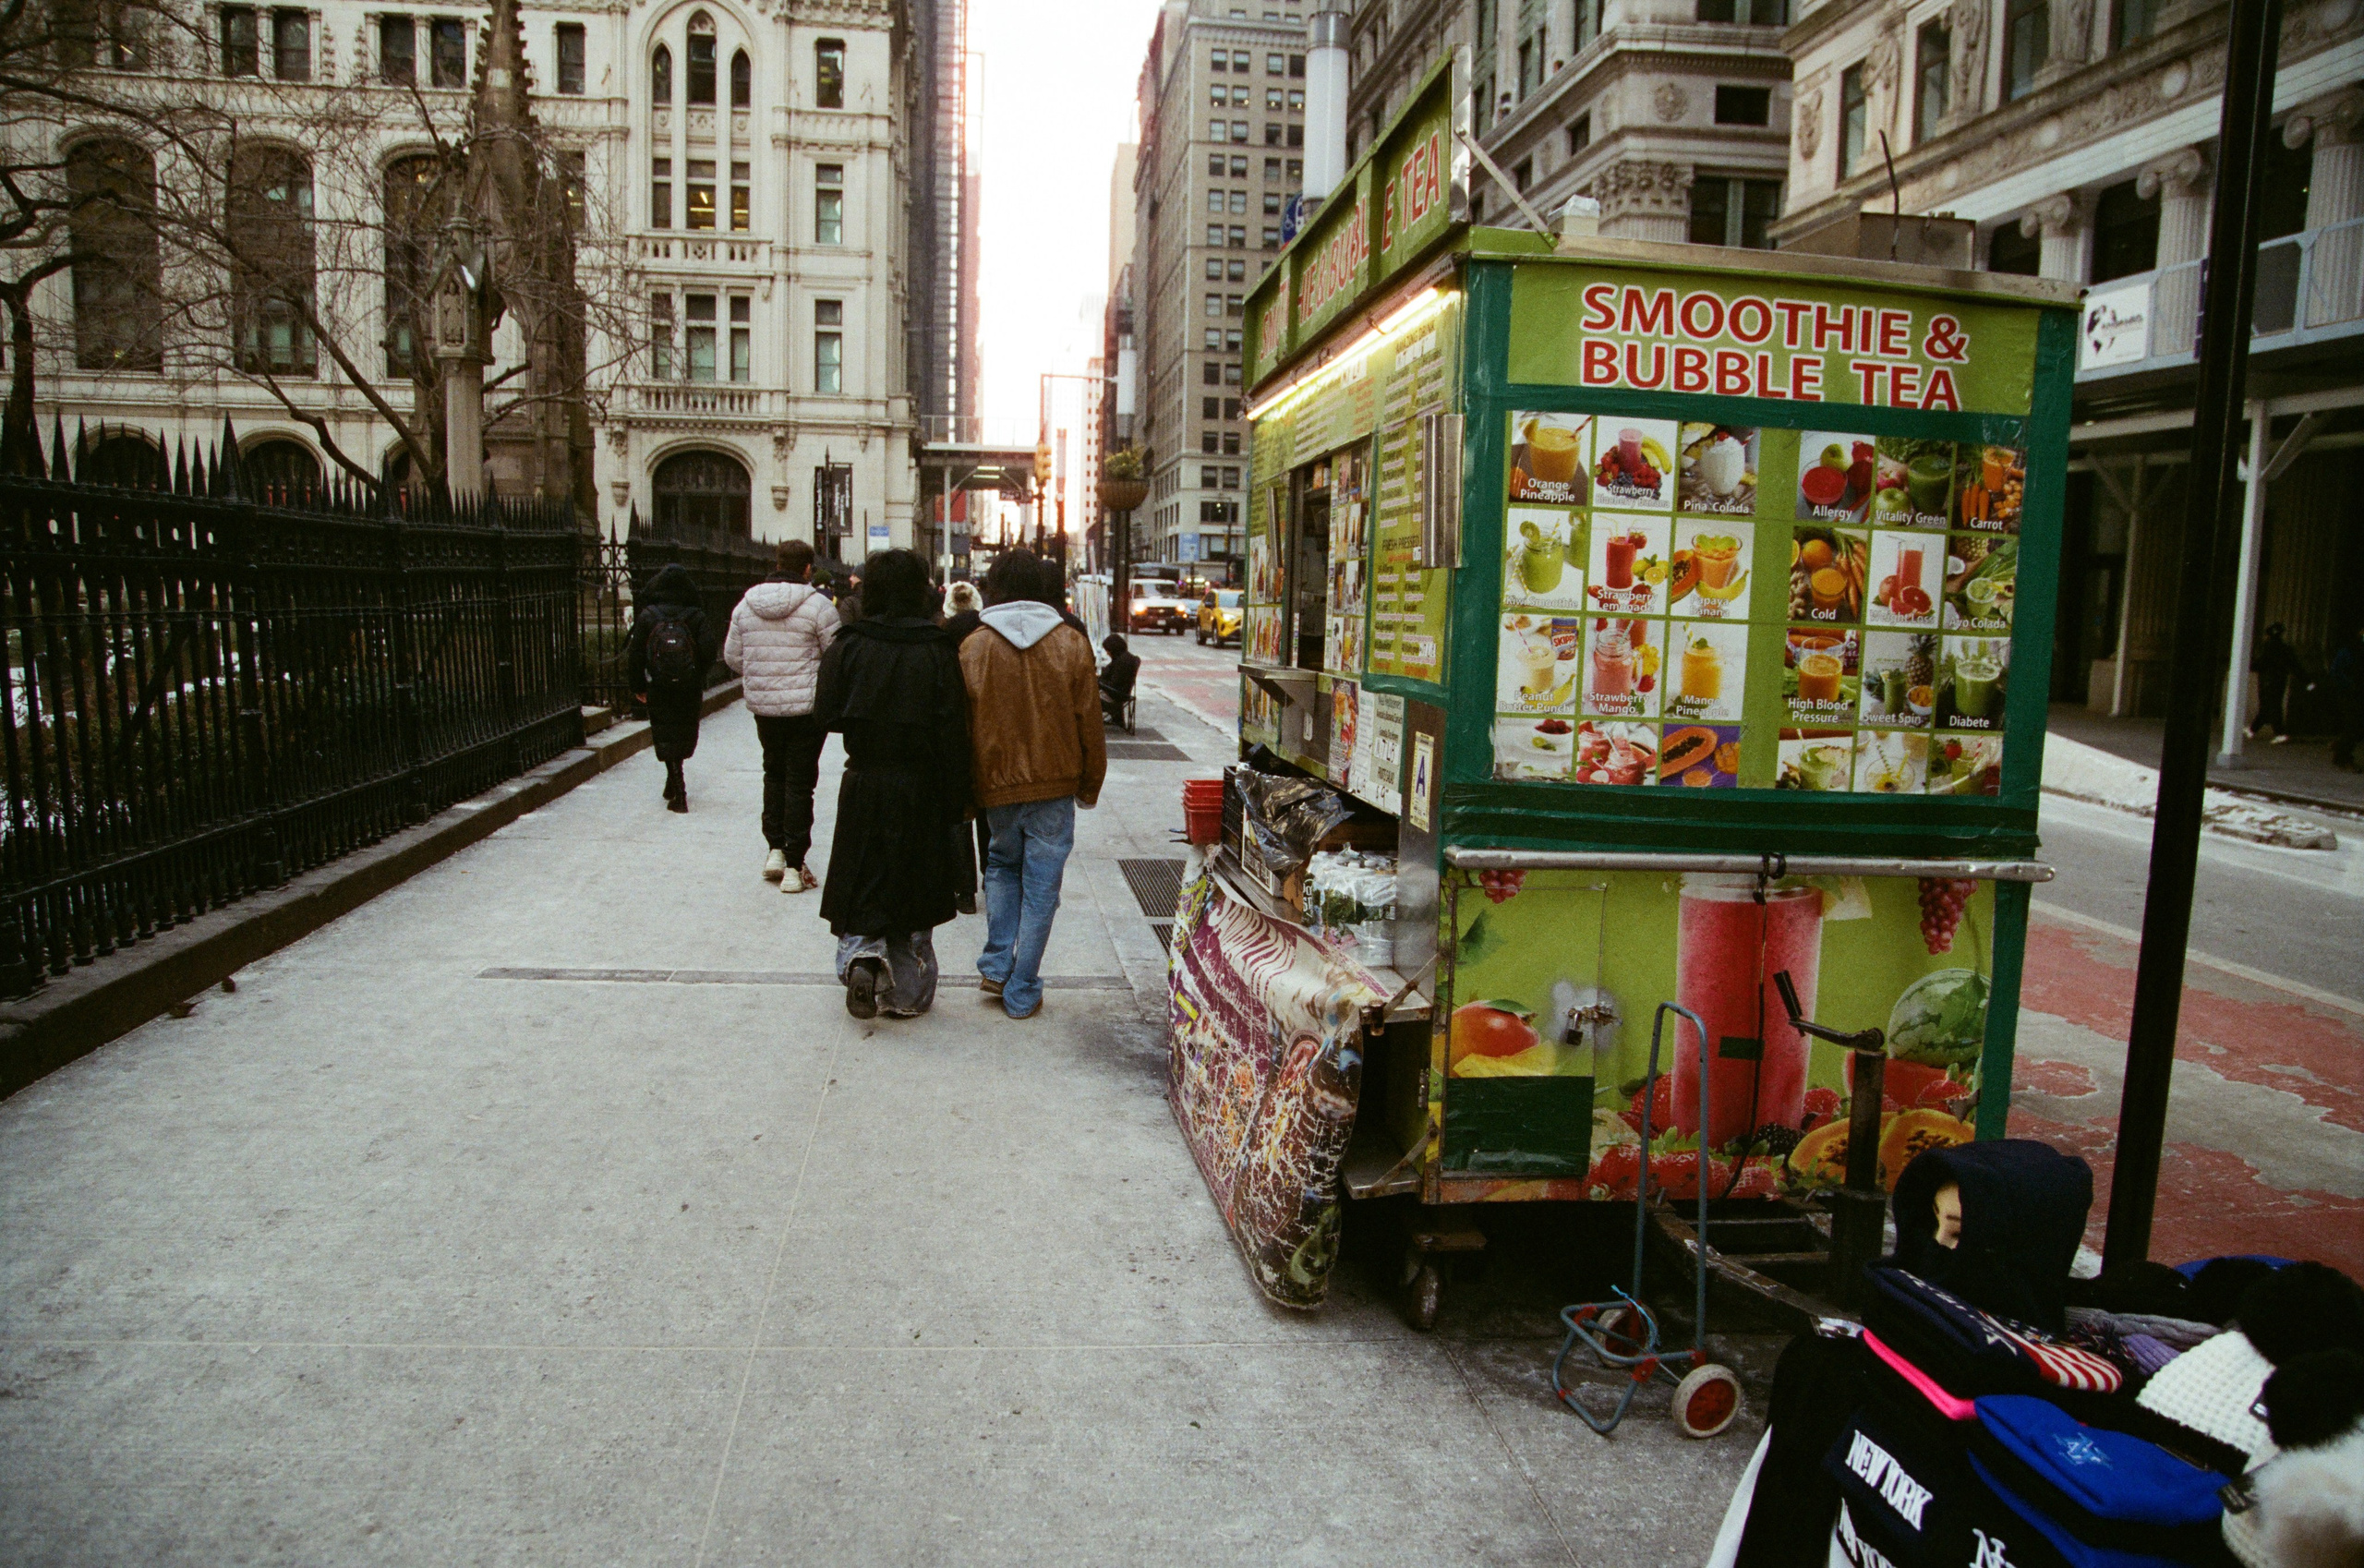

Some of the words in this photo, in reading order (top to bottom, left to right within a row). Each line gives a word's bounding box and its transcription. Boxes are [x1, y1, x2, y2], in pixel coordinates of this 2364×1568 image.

[1401, 131, 1441, 235] TEA
[1581, 283, 1912, 359] SMOOTHIE
[1924, 314, 1969, 363] &
[1580, 337, 1825, 402] BUBBLE
[1850, 360, 1962, 411] TEA
[1527, 478, 1570, 492] Orange
[1607, 483, 1656, 498] Strawberry
[1519, 489, 1575, 503] Pineapple
[1683, 500, 1707, 512] Pina
[1712, 501, 1750, 514] Colada
[1812, 505, 1853, 522] Allergy
[1876, 510, 1913, 525] Vitality
[1915, 513, 1947, 525] Green
[1970, 516, 2004, 531] Carrot
[1506, 595, 1528, 606] Kiwi
[1529, 597, 1579, 609] Smoothie
[1597, 589, 1657, 602] Strawberry
[1691, 596, 1730, 608] Papaya
[1597, 600, 1655, 613] Lemonade
[1690, 606, 1730, 617] Banana
[1811, 607, 1837, 621] Cold
[1869, 609, 1910, 625] Weight
[1910, 611, 1935, 624] Loss
[1971, 617, 2007, 630] Colada
[1514, 689, 1554, 702] Peanut
[1589, 691, 1649, 705] Strawberry
[1684, 694, 1720, 706] Mango
[1499, 699, 1534, 713] Butter
[1536, 701, 1571, 713] Punch
[1598, 703, 1636, 715] Mango
[1675, 705, 1729, 718] Pineapple
[1788, 697, 1814, 712] High
[1816, 698, 1848, 711] Blood
[1791, 711, 1839, 723] Pressure
[1863, 712, 1896, 723] Sweet
[1949, 715, 1990, 728] Diabete
[1416, 755, 1426, 797] A
[1845, 1429, 1893, 1487] NEW
[1880, 1457, 1934, 1531] YORK
